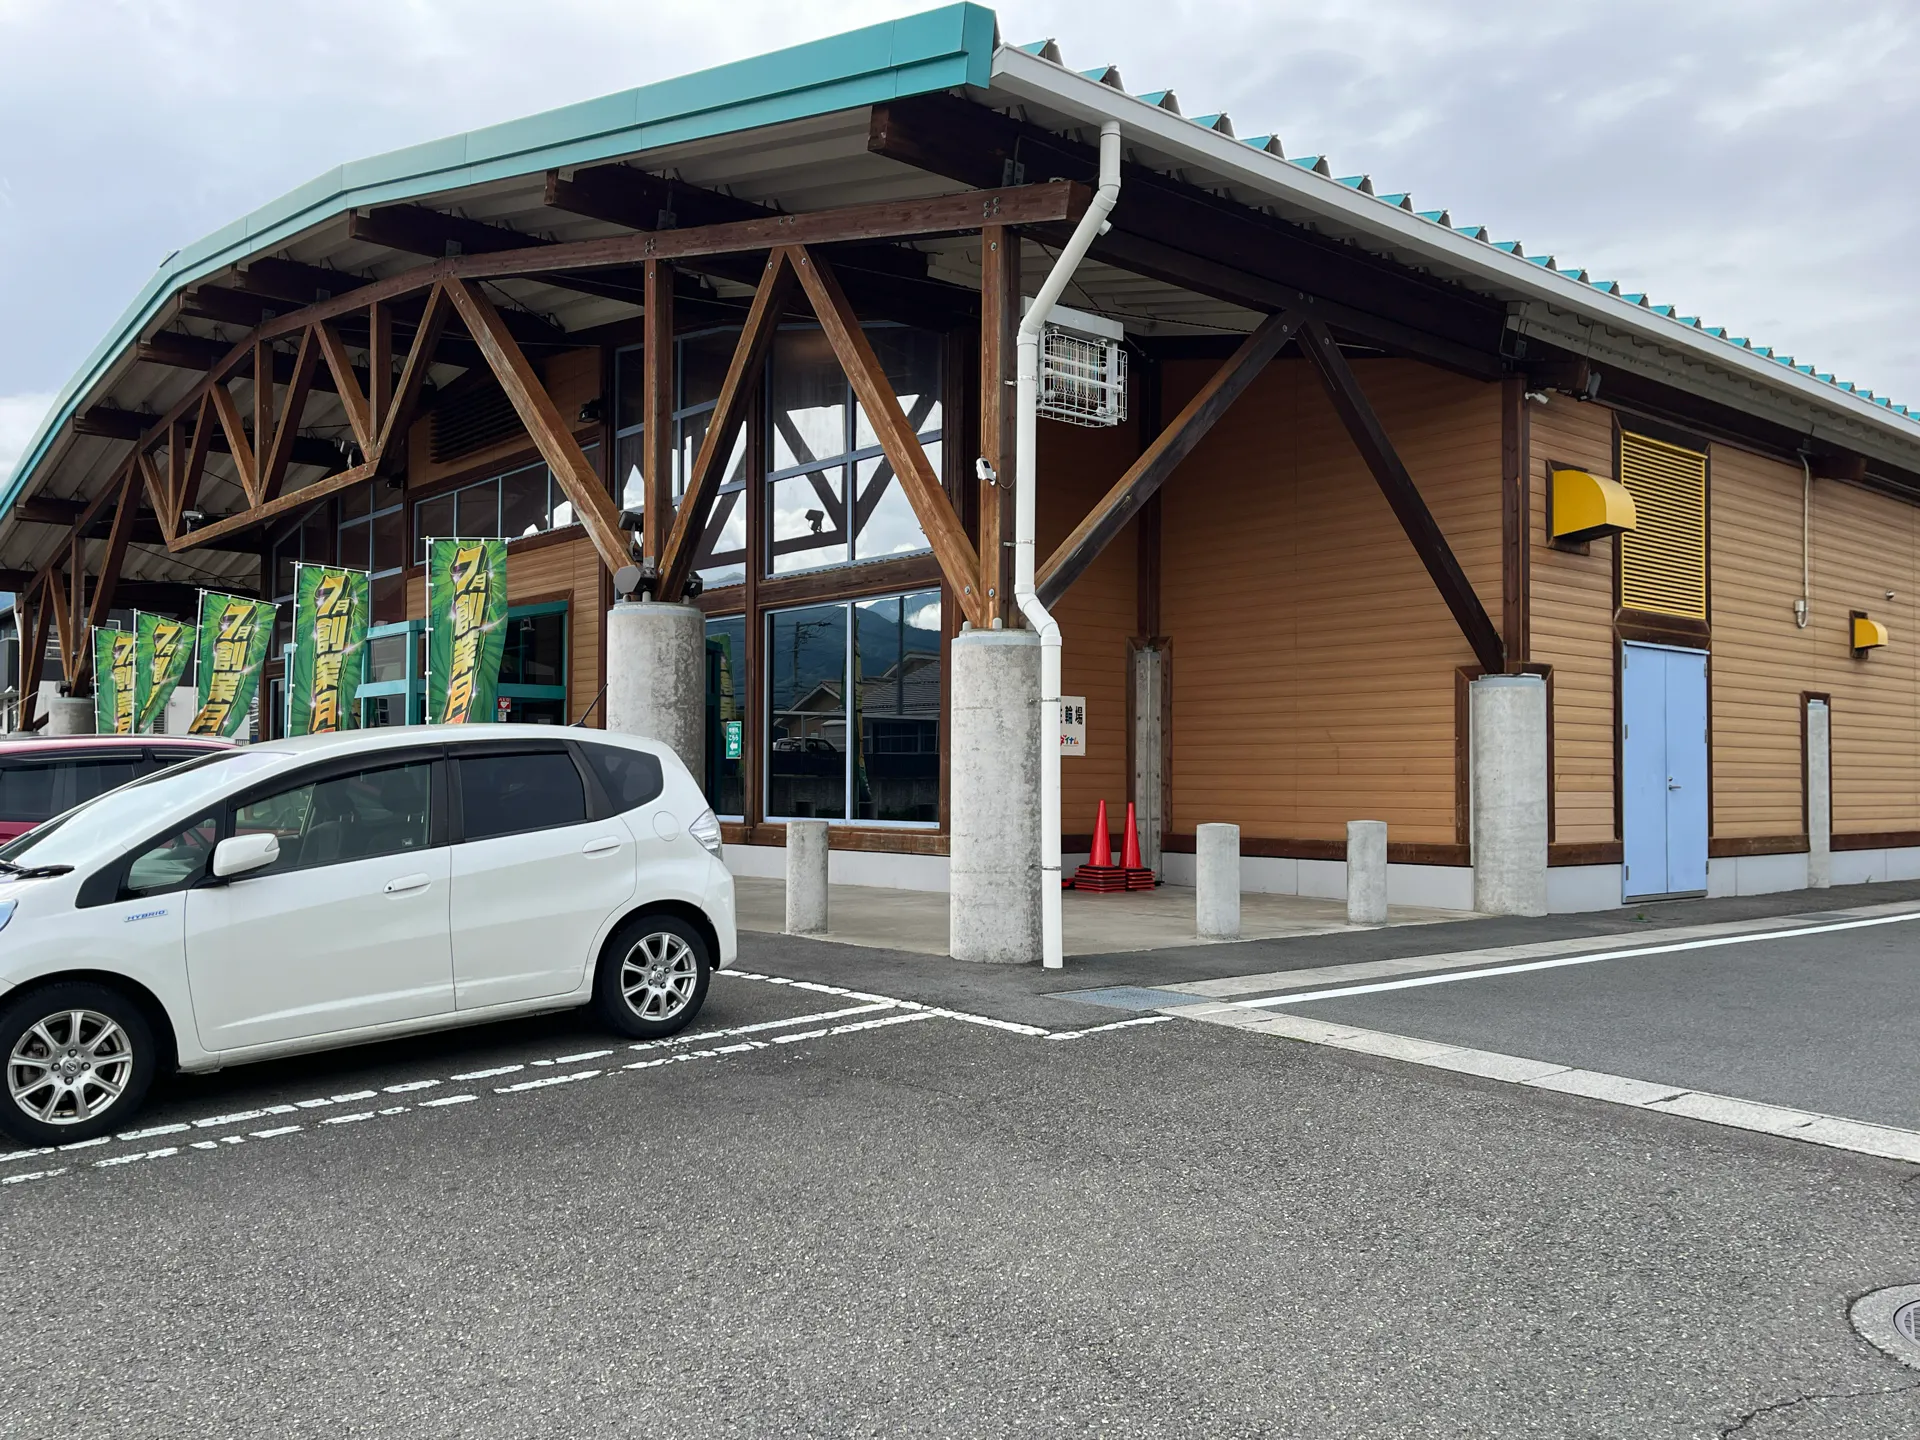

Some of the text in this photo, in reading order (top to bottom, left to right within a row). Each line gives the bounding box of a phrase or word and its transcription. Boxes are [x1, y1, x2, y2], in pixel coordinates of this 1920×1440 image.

[187, 604, 253, 736] 7月創業月
[312, 575, 350, 734] 7月創業月
[444, 546, 488, 723] 7月創業月
[1060, 705, 1083, 725] 輪場
[127, 909, 165, 920] HYBRID
